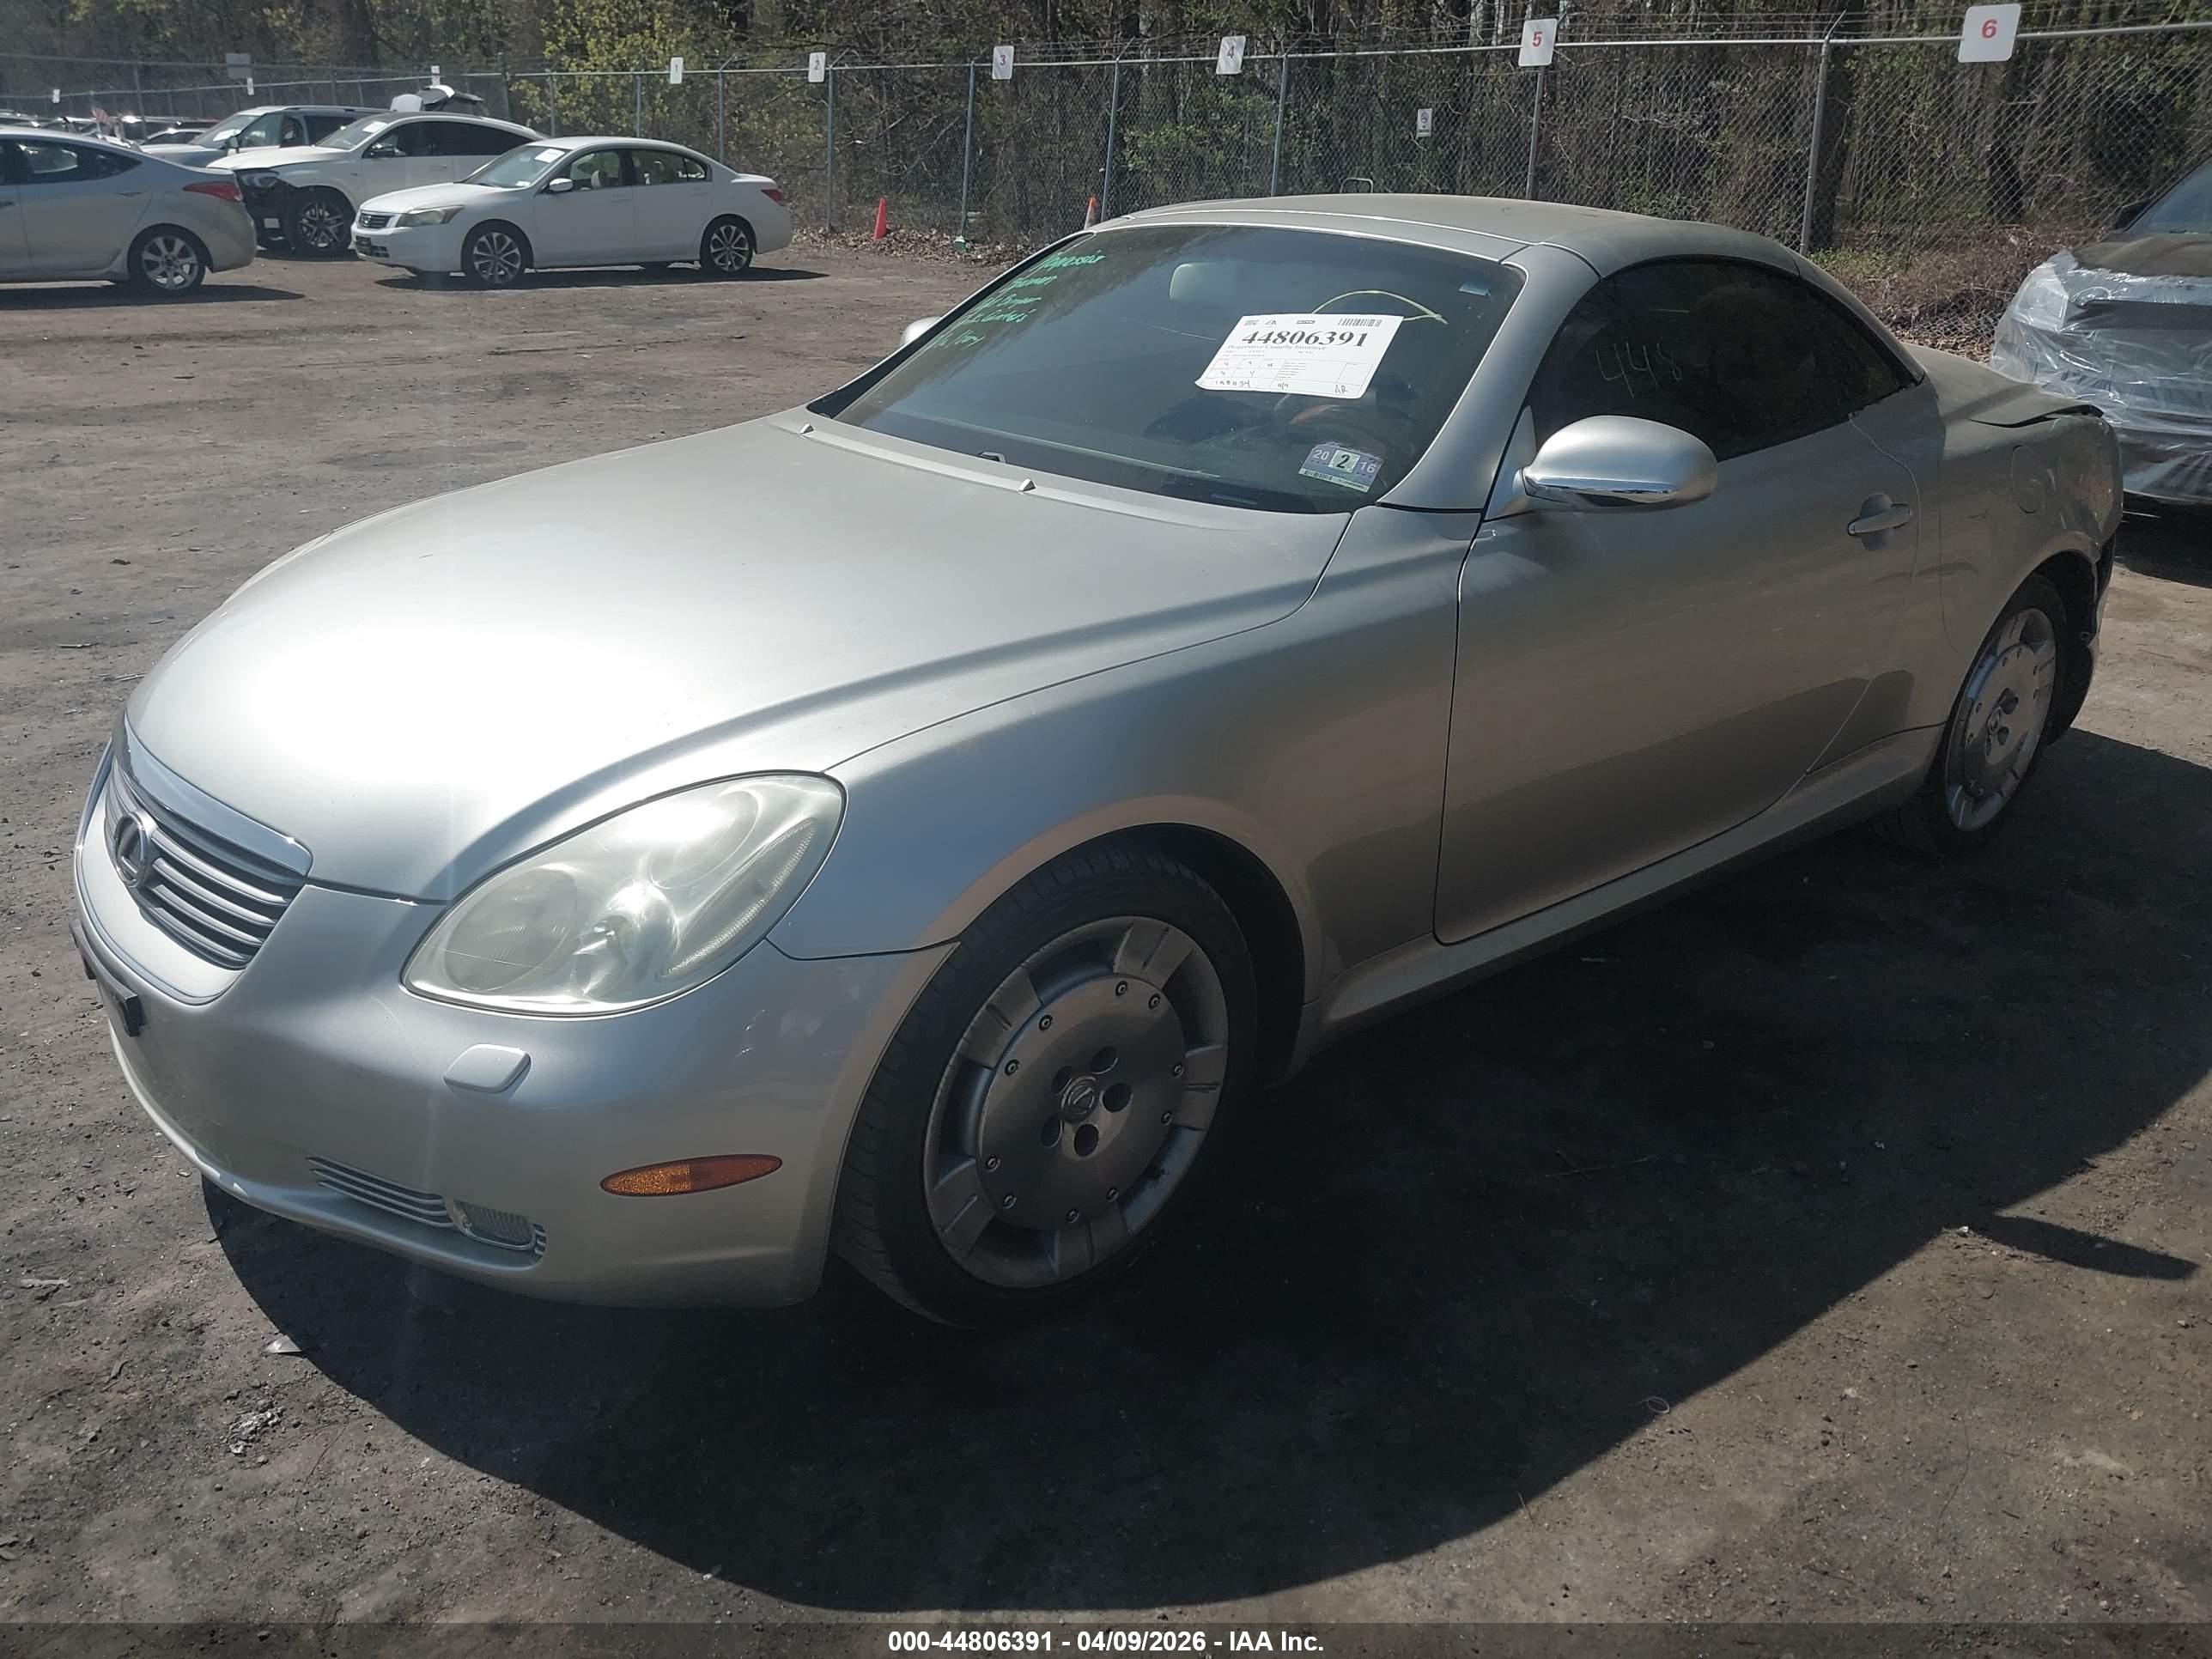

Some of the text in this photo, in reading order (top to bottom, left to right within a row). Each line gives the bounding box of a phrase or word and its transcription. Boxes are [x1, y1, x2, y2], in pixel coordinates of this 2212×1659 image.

[1981, 19, 1998, 39] 6
[1532, 31, 1543, 47] 5
[1000, 54, 1006, 66] 3
[1227, 46, 1235, 59] 4
[813, 59, 820, 70] 2
[1242, 331, 1369, 347] 44806391
[1312, 448, 1377, 473] 20 2 16
